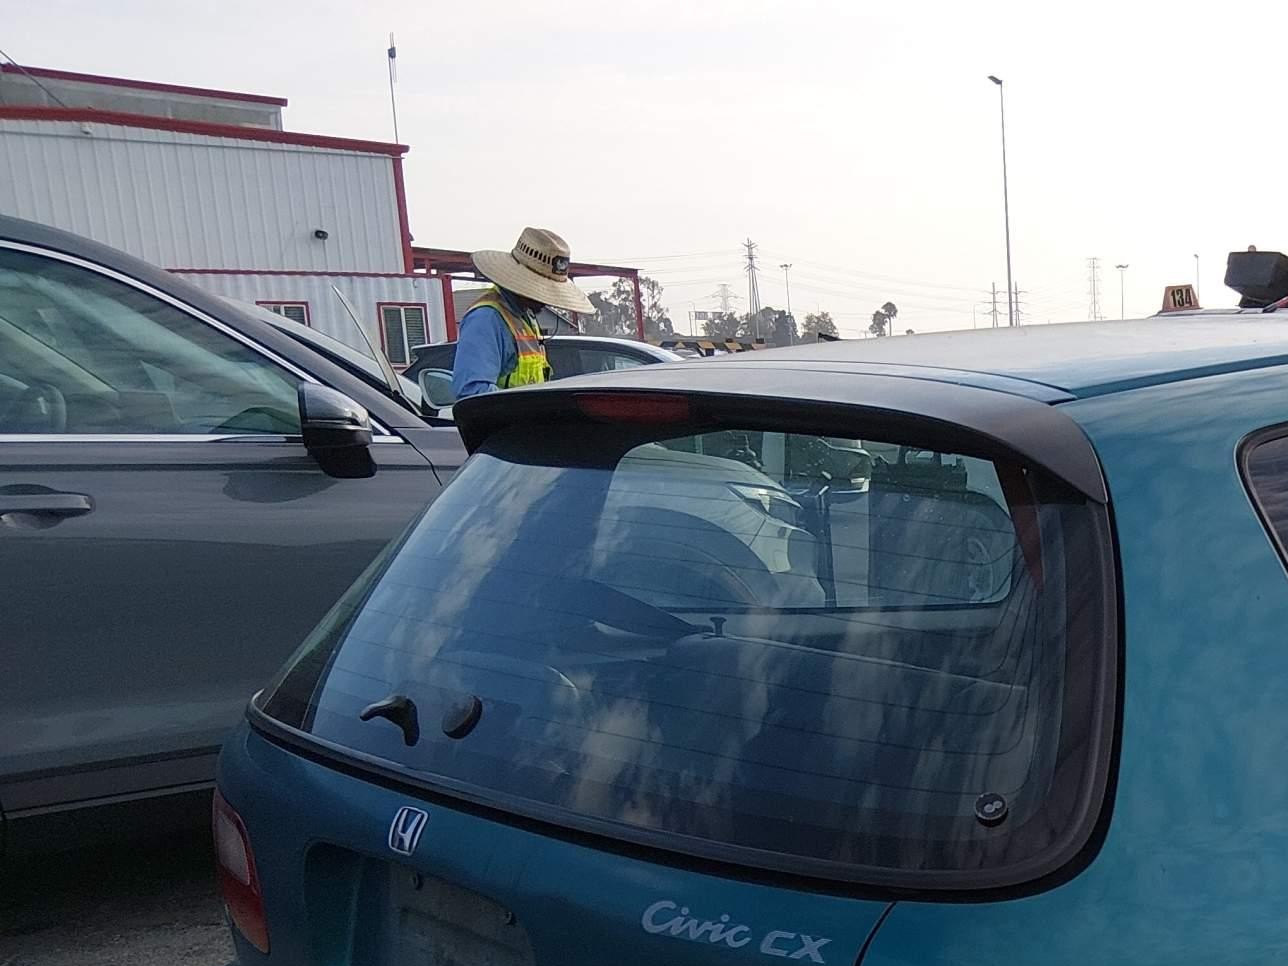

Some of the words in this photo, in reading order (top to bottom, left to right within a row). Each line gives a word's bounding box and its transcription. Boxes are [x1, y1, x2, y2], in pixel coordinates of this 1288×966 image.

[1171, 288, 1192, 307] 134
[641, 900, 751, 948] Civic
[760, 931, 832, 964] CX
